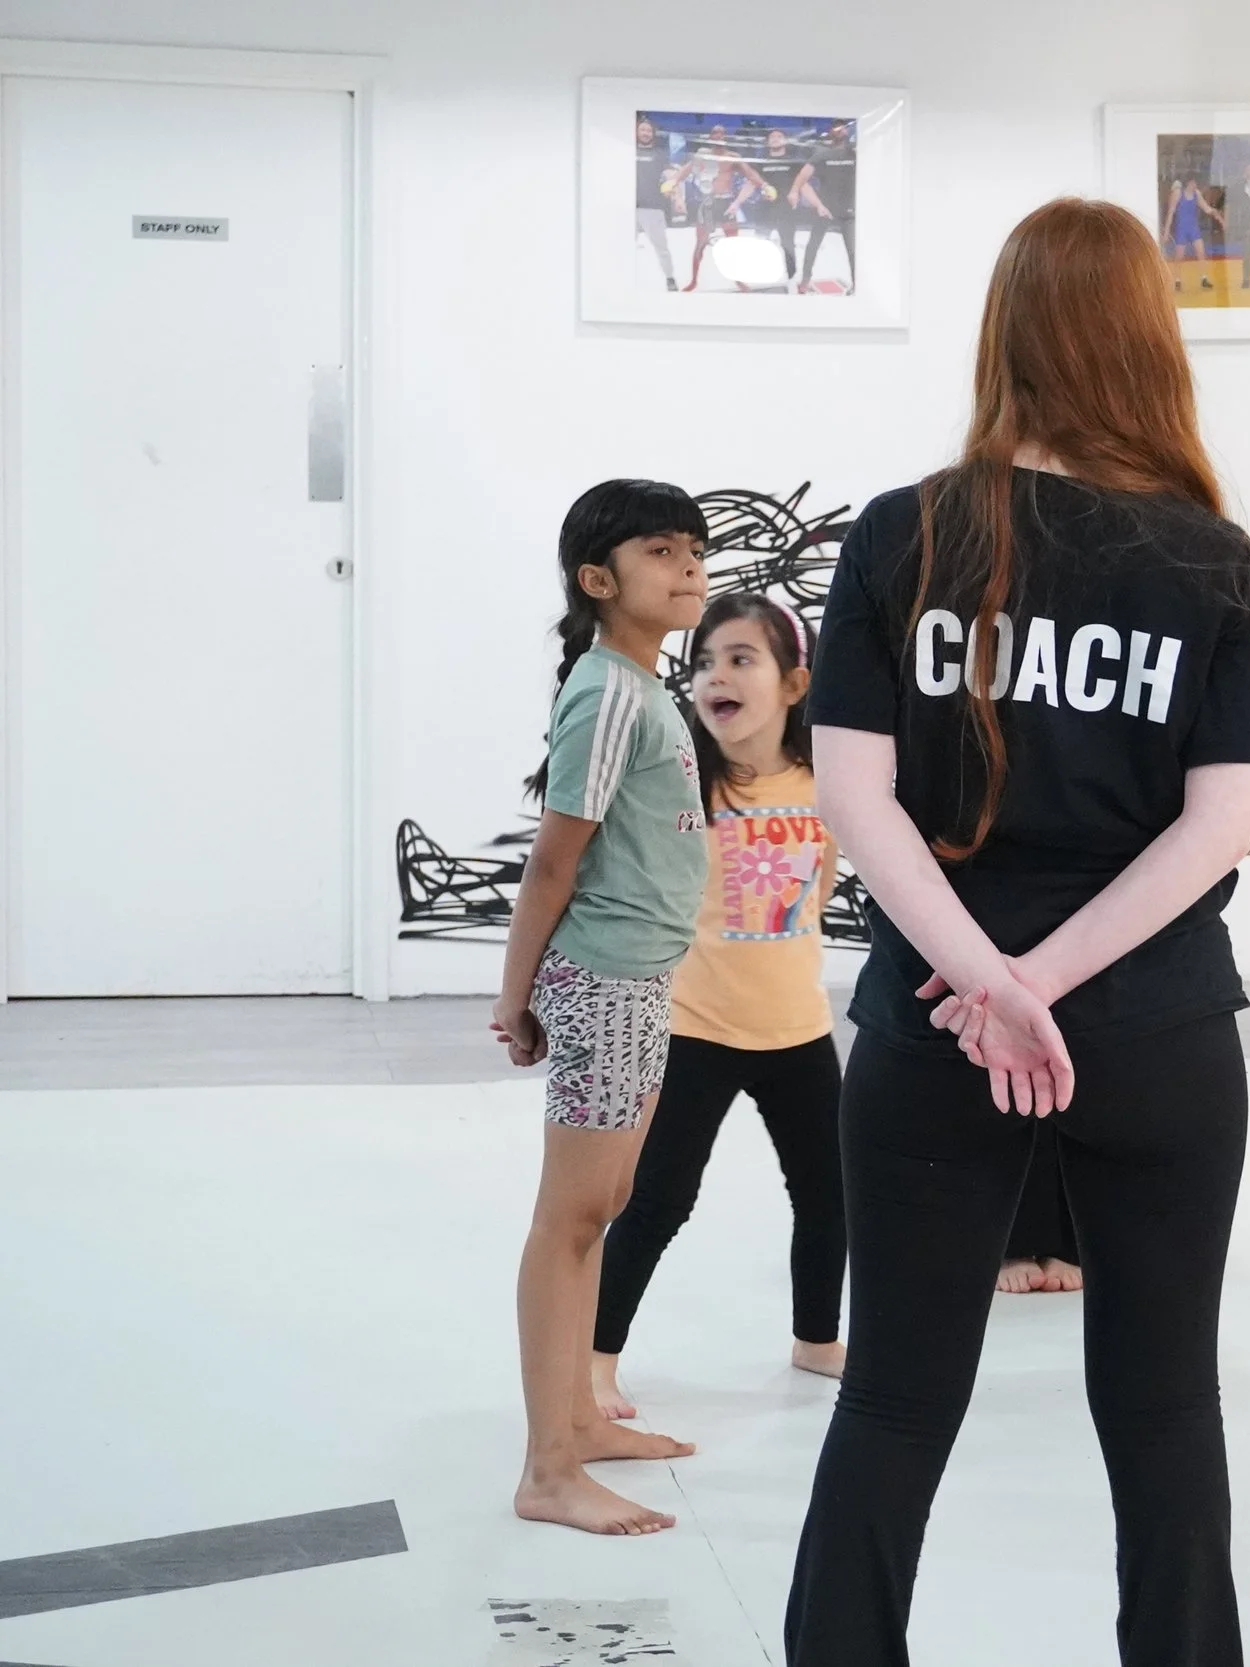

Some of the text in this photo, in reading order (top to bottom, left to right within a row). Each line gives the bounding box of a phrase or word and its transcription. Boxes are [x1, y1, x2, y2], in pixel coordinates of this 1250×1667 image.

[141, 222, 220, 234] STAFF ONLY
[915, 608, 1182, 724] COACH
[744, 815, 823, 846] LOVE
